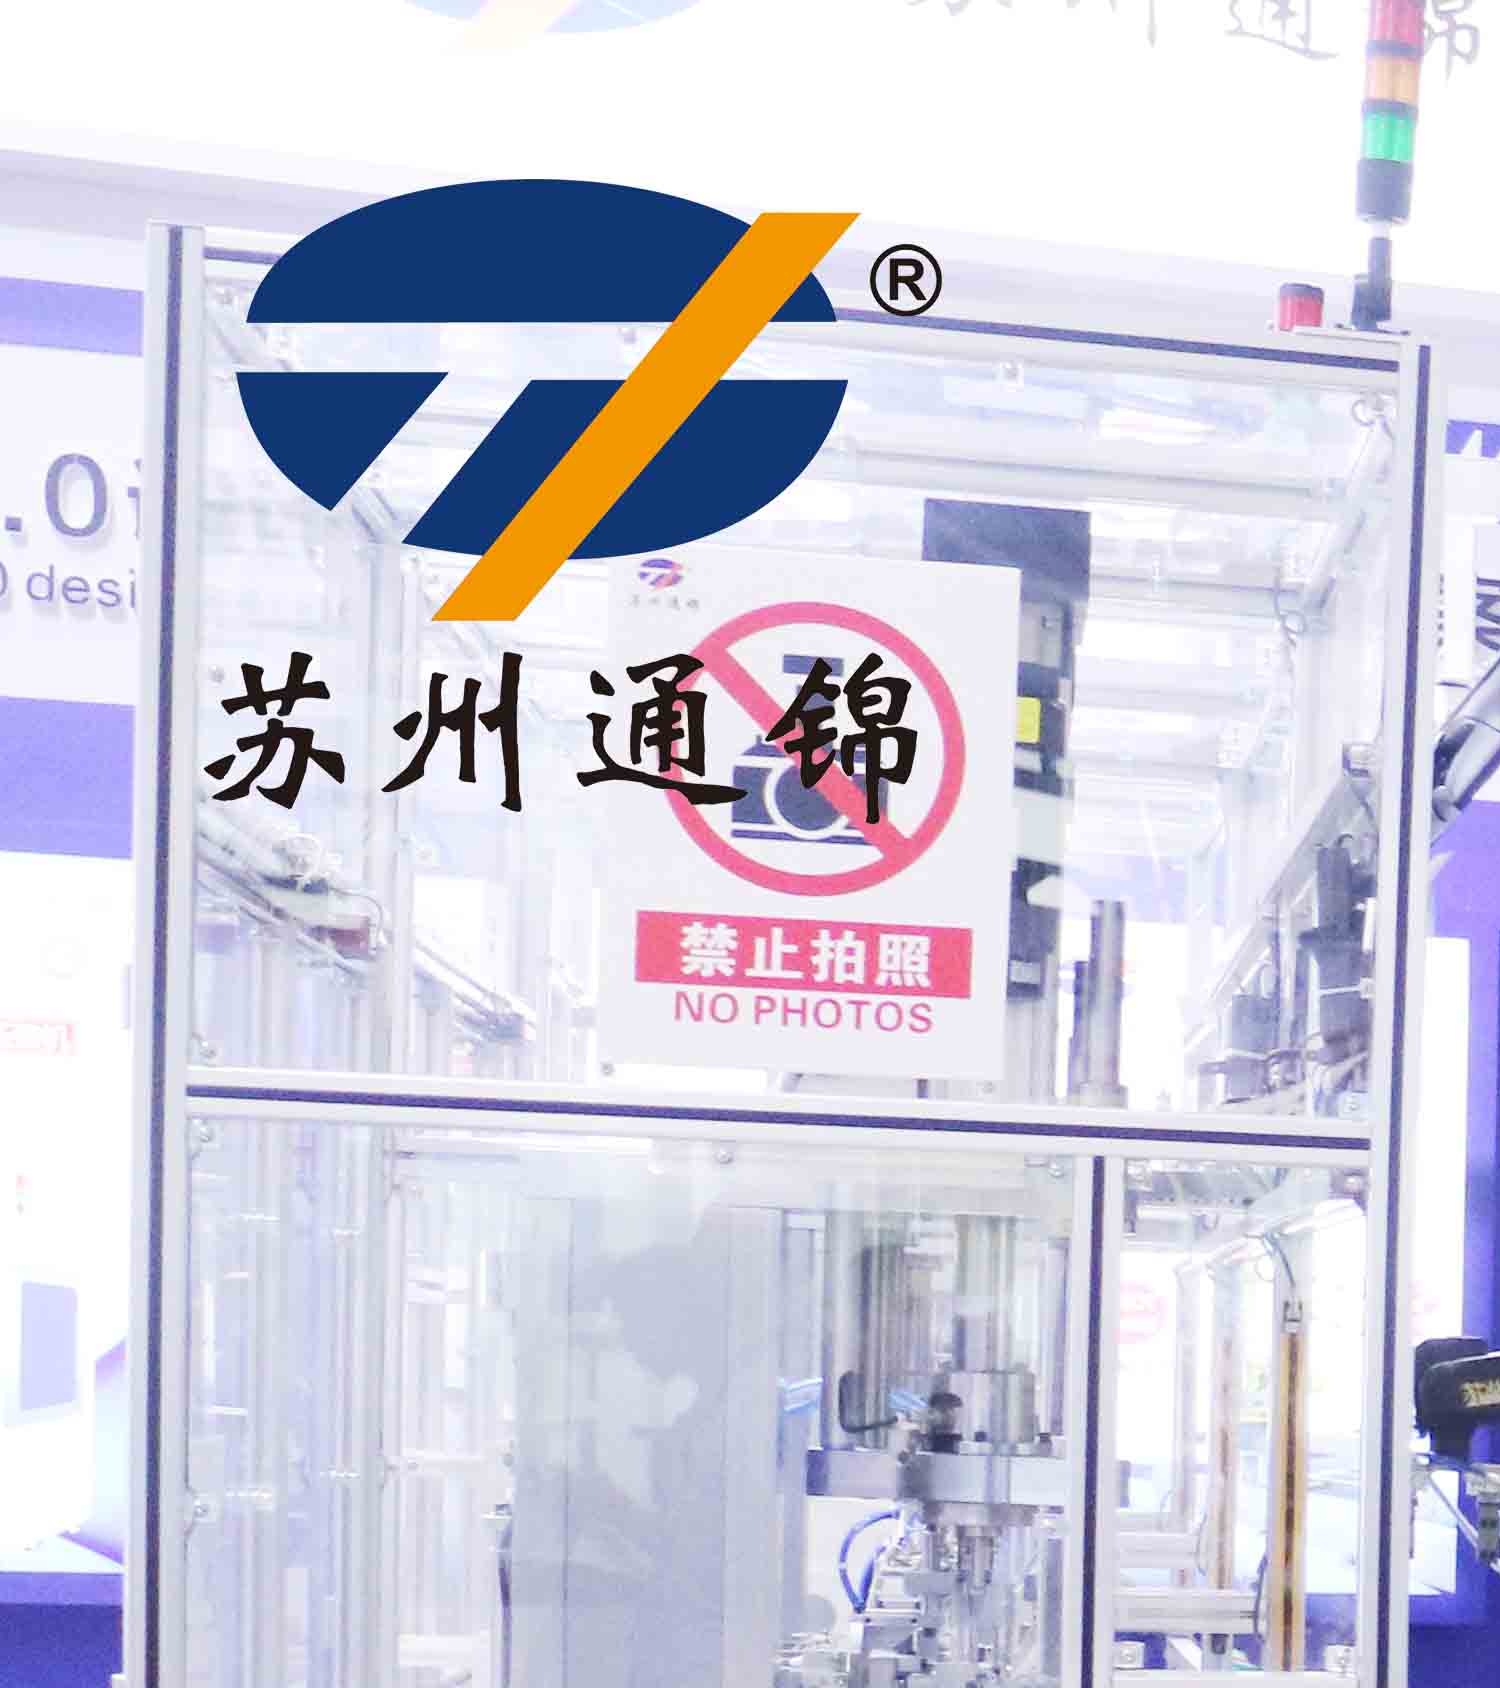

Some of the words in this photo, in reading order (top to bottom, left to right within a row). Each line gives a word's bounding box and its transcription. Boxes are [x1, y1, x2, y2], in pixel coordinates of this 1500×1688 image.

[679, 921, 931, 988] 禁止拍照
[673, 990, 740, 1024] NO
[753, 994, 934, 1034] PHOTOS
